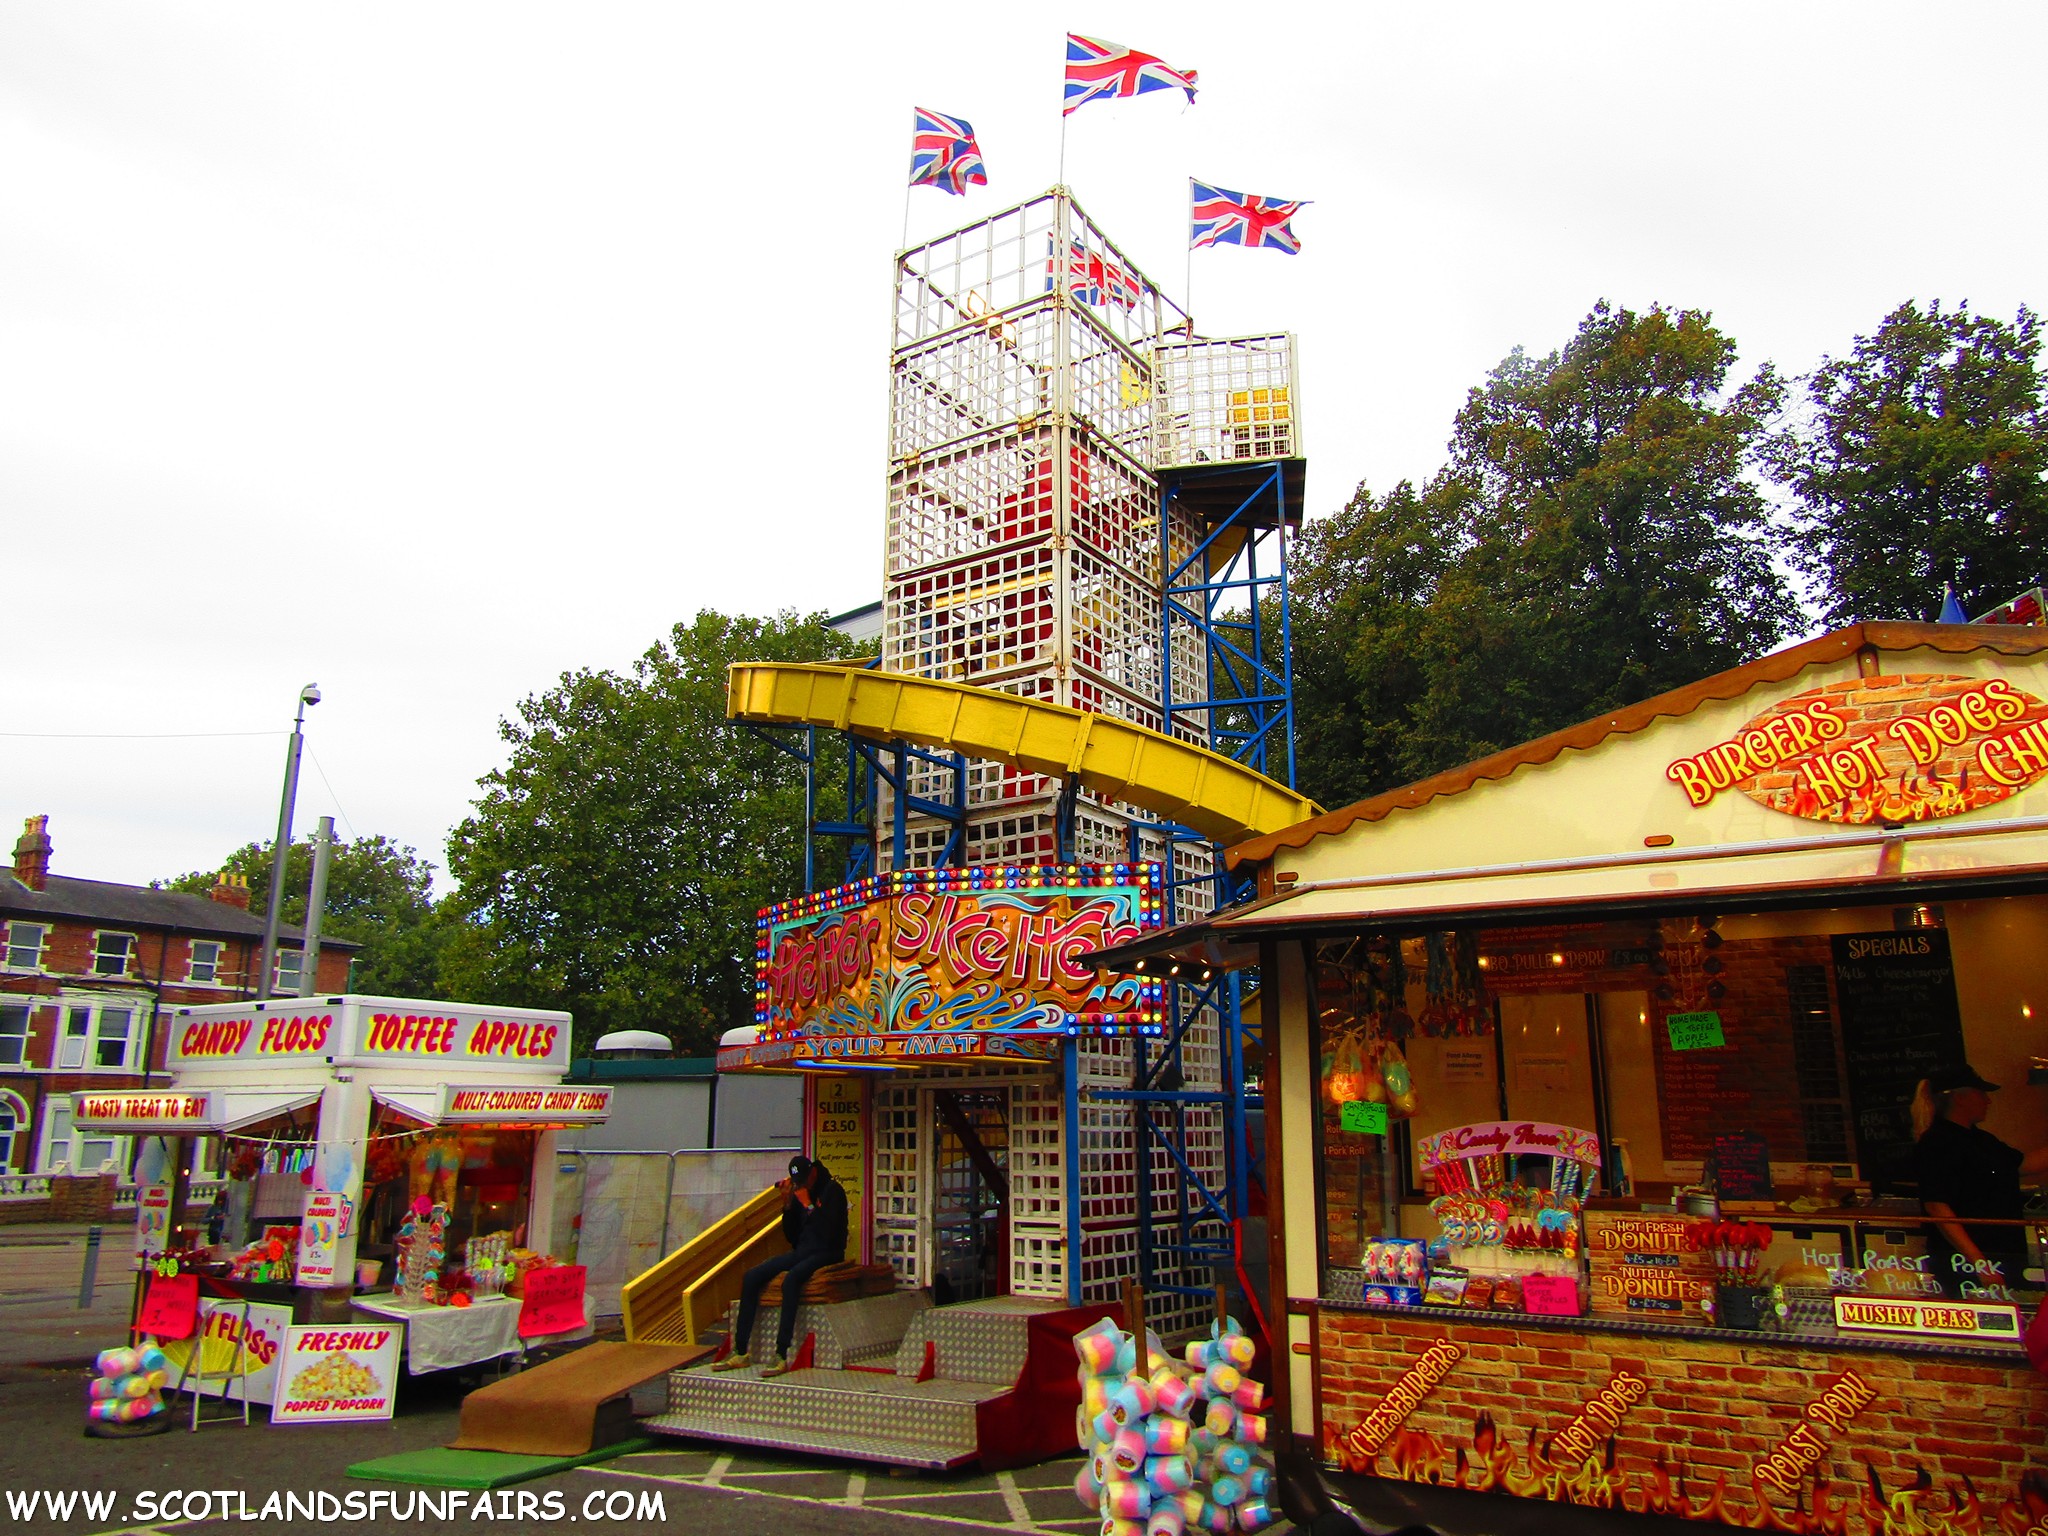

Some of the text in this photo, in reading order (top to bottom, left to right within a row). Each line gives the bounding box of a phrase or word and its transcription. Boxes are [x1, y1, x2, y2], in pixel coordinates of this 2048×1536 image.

[1666, 700, 1847, 807] BURGERS
[1800, 679, 2028, 808] HOT DOGS
[1978, 718, 2048, 785] CHI
[1565, 949, 1606, 968] PORK
[1848, 936, 1931, 960] SPECIALS
[181, 1014, 333, 1057] CANDY FLOSS
[368, 1013, 558, 1058] TOFFEE APPLES
[1686, 1022, 1715, 1031] TOFFEE
[807, 1035, 887, 1057] YOUR
[908, 1034, 980, 1056] MAT
[1678, 1032, 1709, 1045] APPLES
[452, 1090, 609, 1112] MULTI-COLOURED CANDY FLOSS
[834, 1083, 843, 1097] 2
[77, 1097, 208, 1119] A TASTY TREAT TO EAT
[819, 1101, 861, 1115] SLIDES
[821, 1119, 857, 1133] £3.50
[1329, 1145, 1365, 1156] Pork Roll
[1455, 1127, 1512, 1152] Candy
[307, 1208, 337, 1218] COLOURED
[1616, 1220, 1686, 1234] HOT FRESH
[300, 1265, 333, 1276] CANDY FLOSS
[1618, 1266, 1677, 1280] NUTELLA
[1827, 1270, 1870, 1290] BBQ
[1601, 1275, 1702, 1300] DONUTS
[1842, 1302, 1916, 1326] MUSHY
[1921, 1307, 1977, 1331] PEAS
[297, 1330, 391, 1352] FRESHLY
[283, 1398, 387, 1413] POPPED POPCORN
[1350, 1336, 1466, 1460] CHEESEBURGERS
[1554, 1370, 1649, 1464] HOT DOGS
[1755, 1369, 1882, 1497] ROAST PORK
